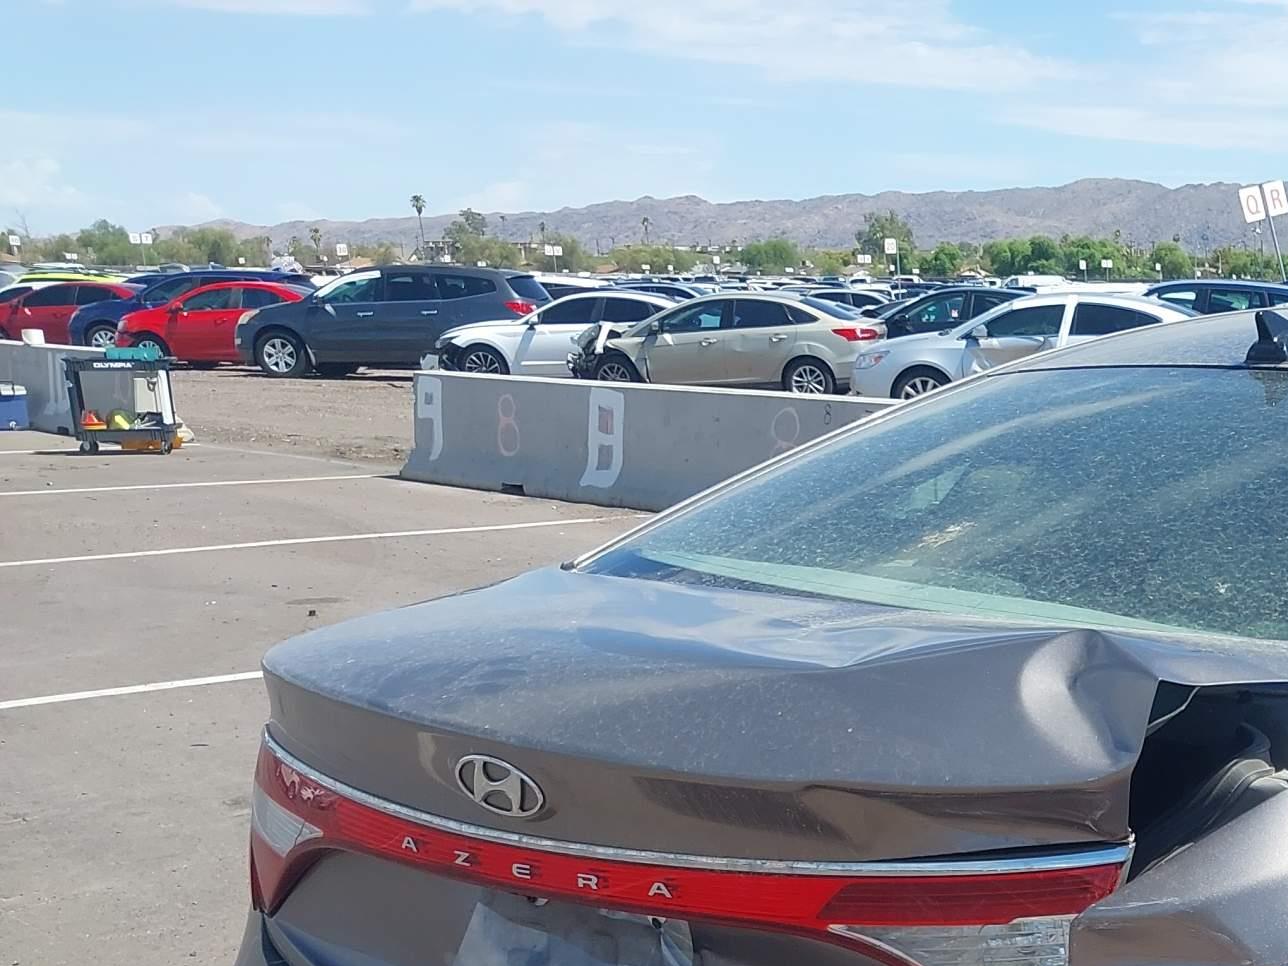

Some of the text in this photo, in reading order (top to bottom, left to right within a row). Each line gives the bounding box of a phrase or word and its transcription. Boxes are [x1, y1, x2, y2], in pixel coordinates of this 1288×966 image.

[1246, 194, 1261, 215] Q
[1270, 188, 1283, 209] R
[498, 393, 520, 456] 8
[401, 836, 673, 899] AZERA
